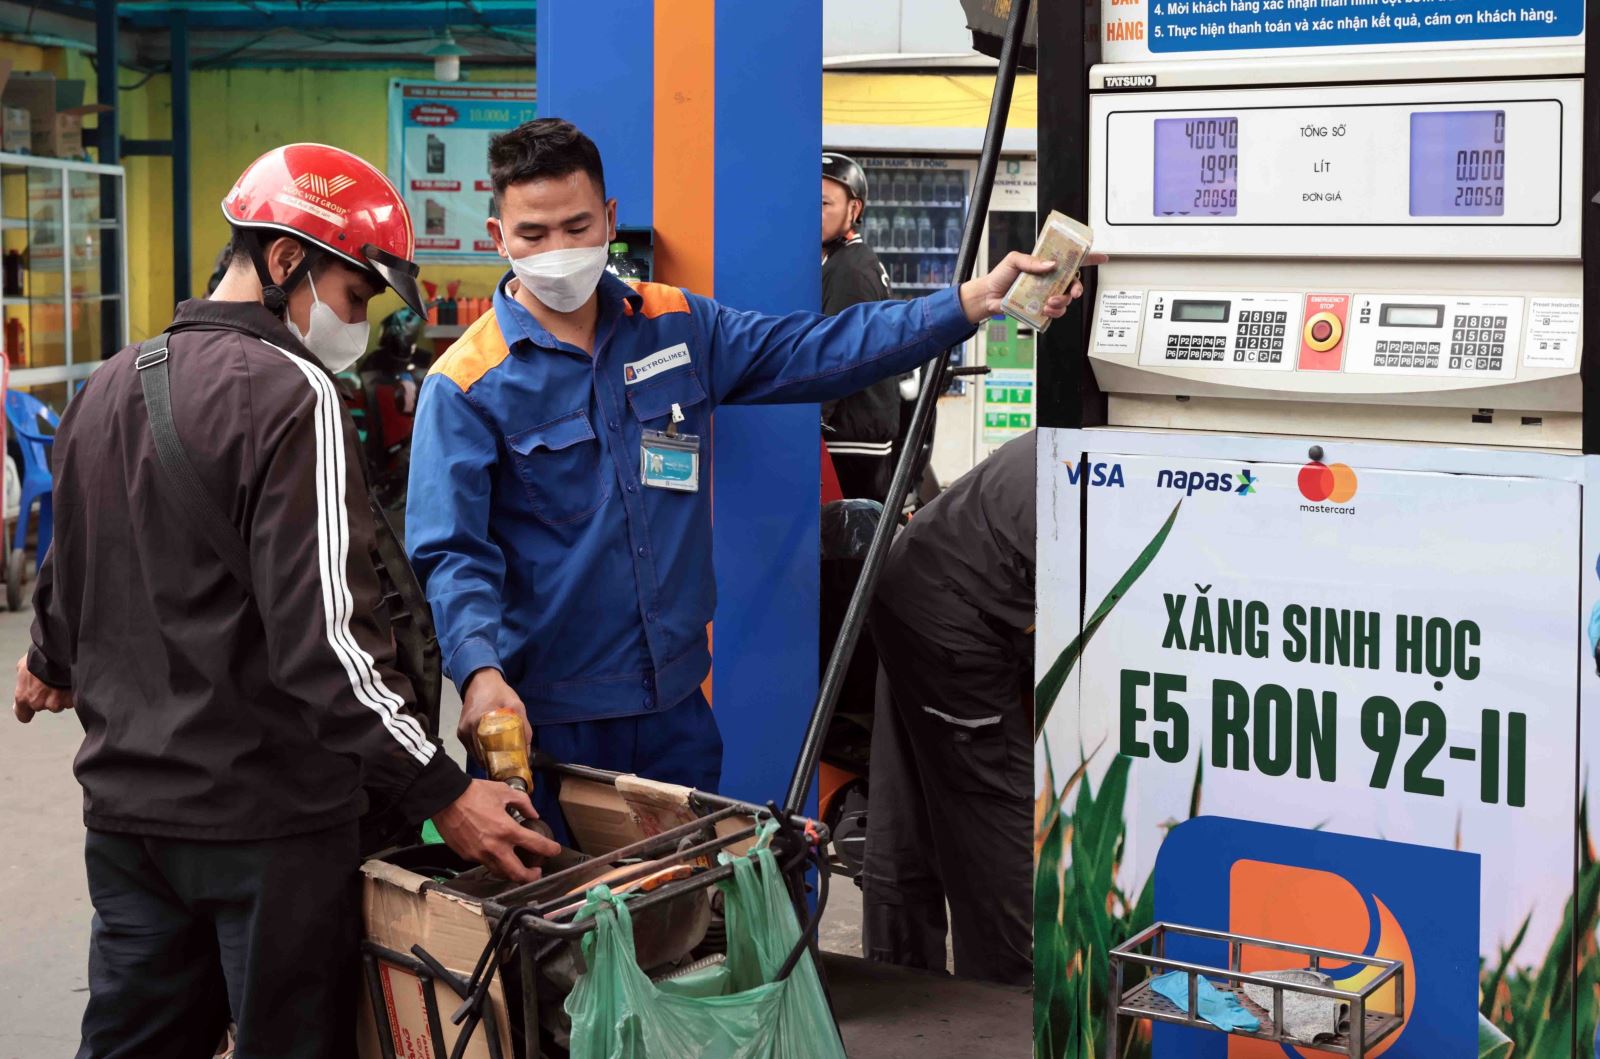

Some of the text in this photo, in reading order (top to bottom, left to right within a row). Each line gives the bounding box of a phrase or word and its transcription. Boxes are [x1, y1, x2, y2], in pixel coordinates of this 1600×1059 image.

[1154, 4, 1164, 15] 4.
[1168, 2, 1189, 14] Mời
[1192, 0, 1227, 13] khách
[1106, 18, 1144, 42] HÀNG
[1154, 8, 1558, 38] 5. Thực hiện thanh toán và xác nhận kết quả, cám ơn khách hàng.
[1106, 76, 1154, 88] TATSUNO
[1186, 120, 1238, 150] 40040
[1300, 124, 1346, 138] TỔNG SỐ
[1494, 112, 1505, 144] 0
[1314, 159, 1331, 172] LÍT
[1194, 189, 1237, 208] 20050
[1302, 190, 1342, 202] ĐƠN GIÁ
[1455, 186, 1504, 206] 20050
[320, 199, 347, 215] GROUP
[636, 350, 688, 374] PETROLIMEX
[1156, 469, 1232, 496] napas
[1300, 504, 1355, 515] mastercard
[1162, 583, 1481, 692] XĂNG SINH HỌC
[1119, 668, 1526, 808] E5 RON 92-II
